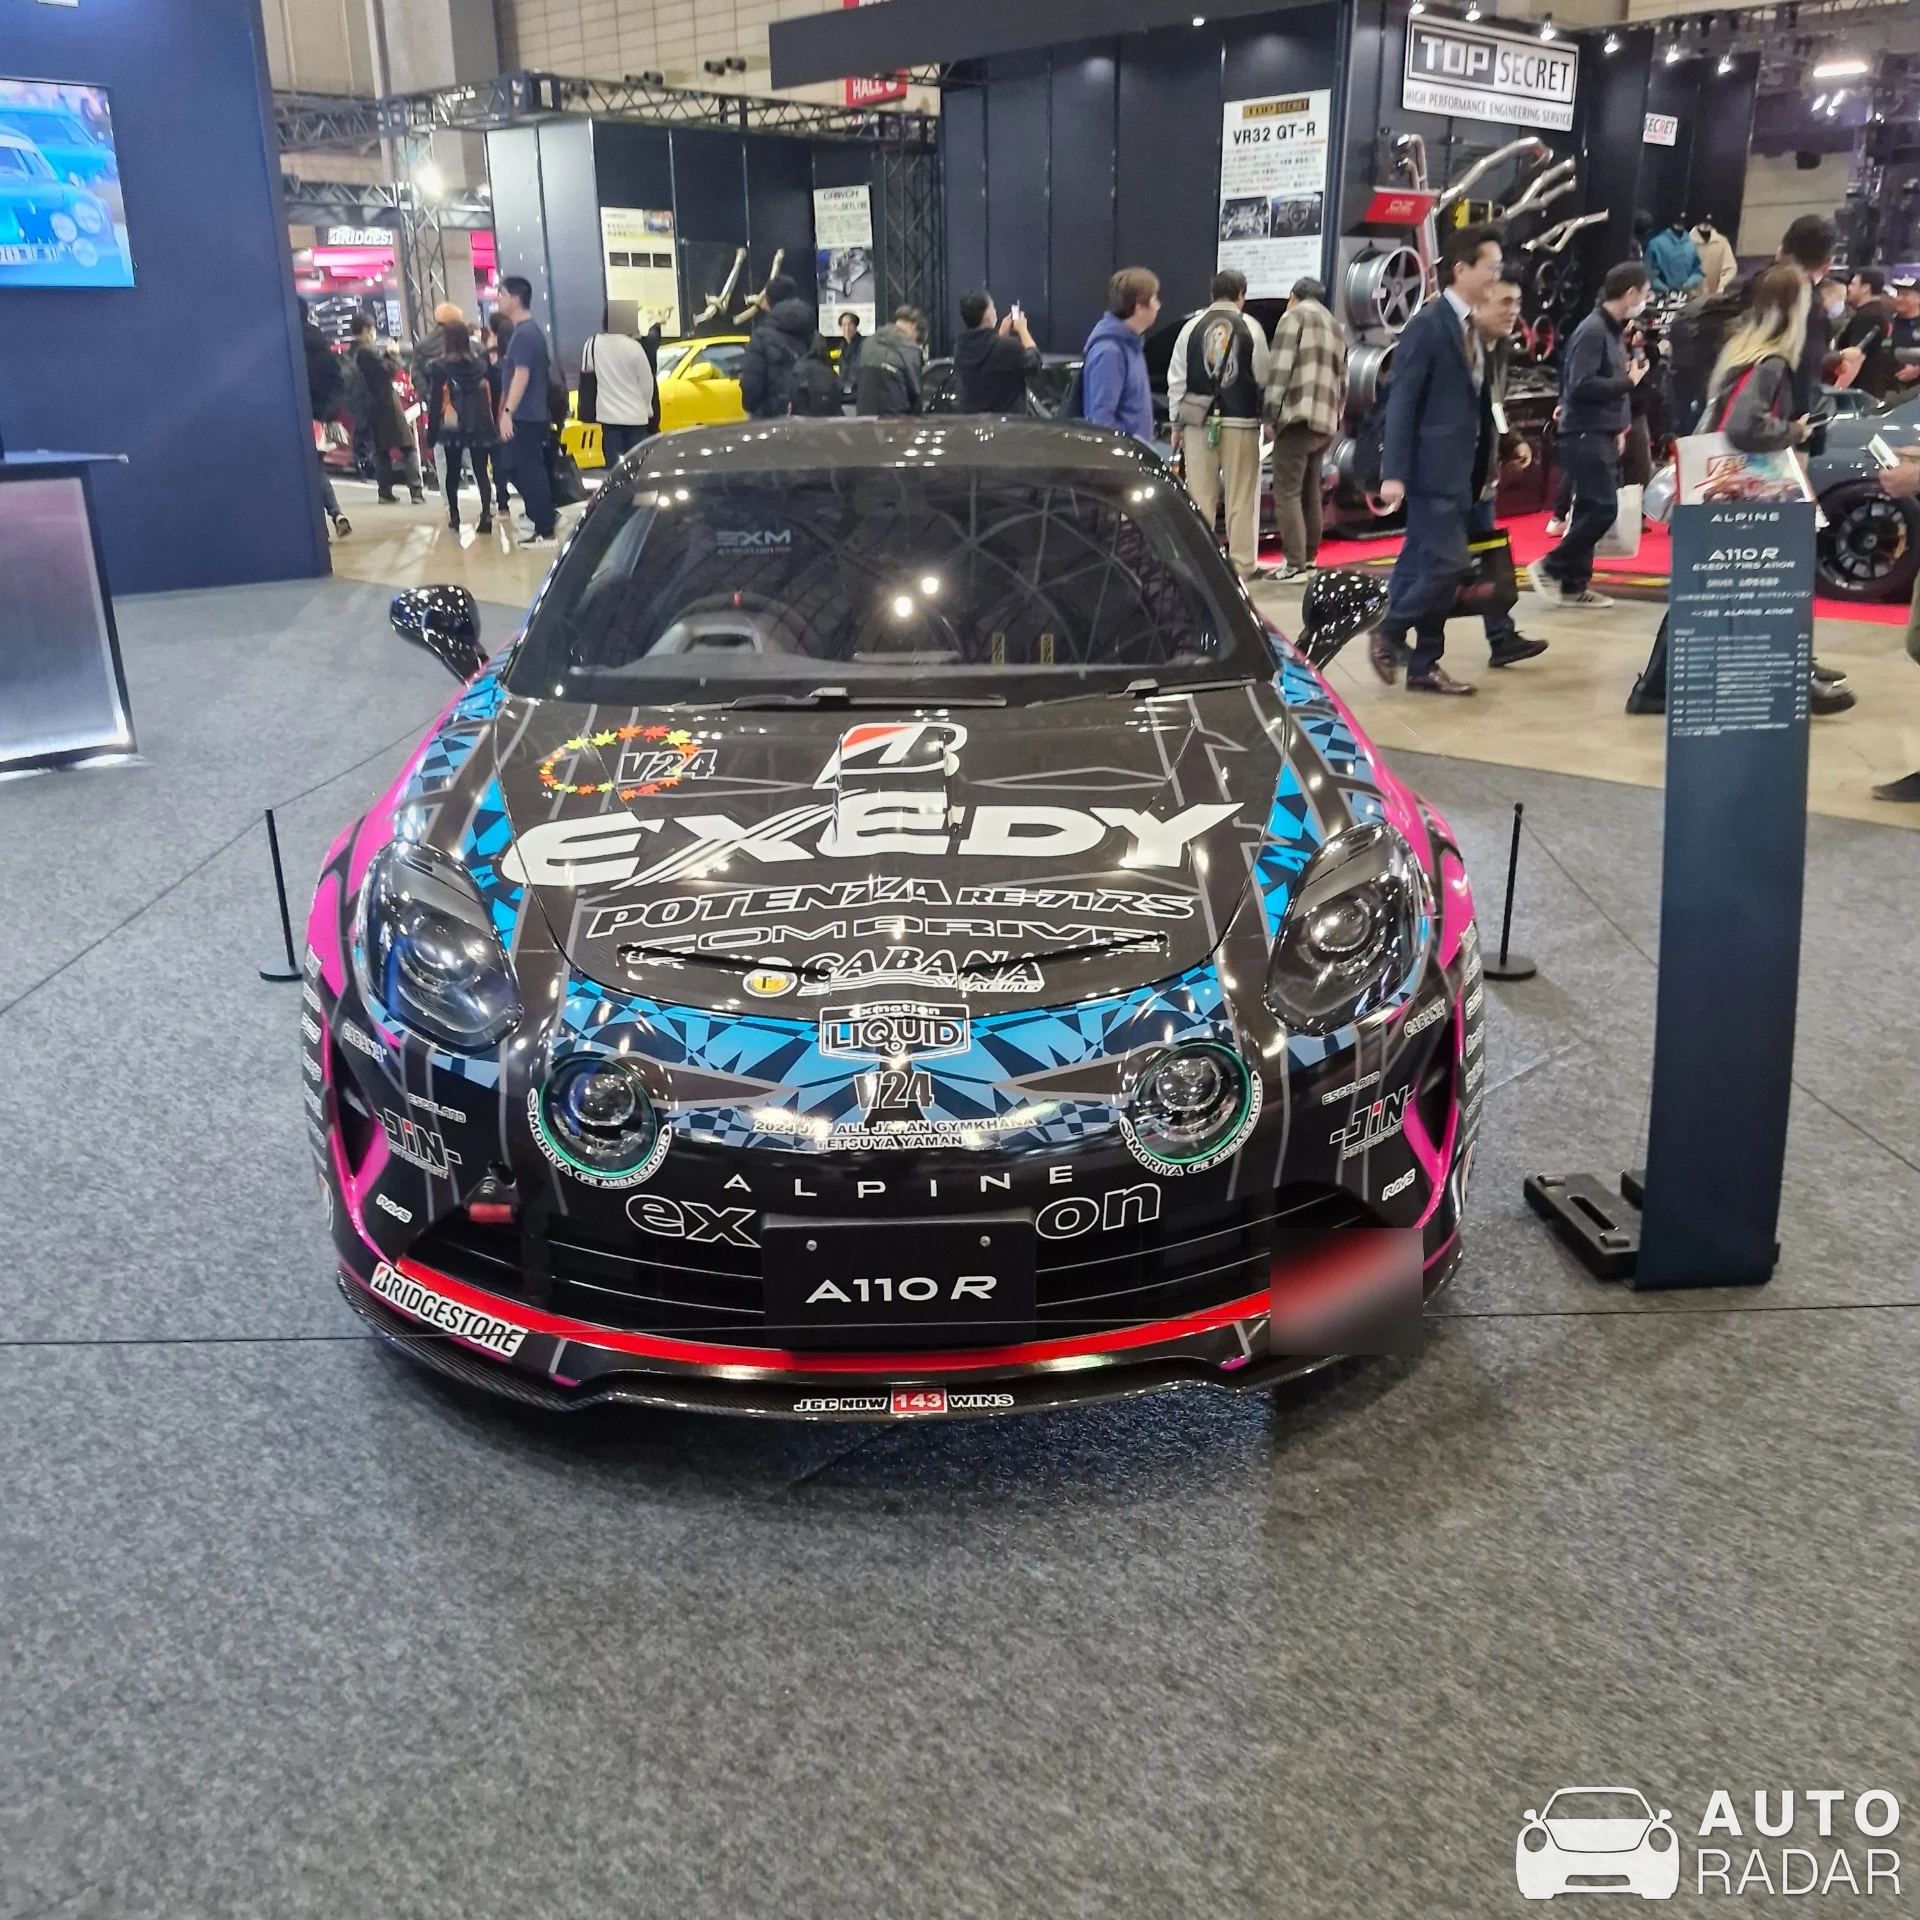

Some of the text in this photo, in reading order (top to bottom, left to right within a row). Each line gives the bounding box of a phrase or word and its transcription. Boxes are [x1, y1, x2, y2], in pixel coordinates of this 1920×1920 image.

[1420, 35, 1571, 93] TOP SECRET
[1406, 91, 1573, 126] HIGH PERFORMANCE ENGINEERING SERVICE
[1233, 121, 1316, 145] VR32 GT-R
[1711, 512, 1780, 523] ALPINE
[1708, 547, 1780, 561] A110 R
[616, 748, 719, 785] V24
[502, 790, 1245, 890] EXEDY
[586, 878, 1197, 940] POTENZA RE-71RS
[801, 945, 1046, 987] CABANA
[828, 1017, 963, 1055] LIQUID
[753, 1121, 798, 1136] 2024
[835, 1122, 870, 1136] ALL
[1191, 1078, 1262, 1173] PR AMBASSADOR
[526, 1111, 574, 1178] MORIYA
[579, 1132, 670, 1188] PR AMBASSADOR
[816, 1136, 900, 1151] TETSUYA
[1126, 1139, 1185, 1177] MORIYA
[723, 1165, 1074, 1199] ALPINE
[1382, 1168, 1417, 1202] RAYS
[376, 1193, 413, 1224] RAYS
[805, 1276, 998, 1304] A110 R
[839, 1397, 888, 1412] NOW
[895, 1392, 944, 1409] 143
[947, 1393, 1015, 1409] WINS
